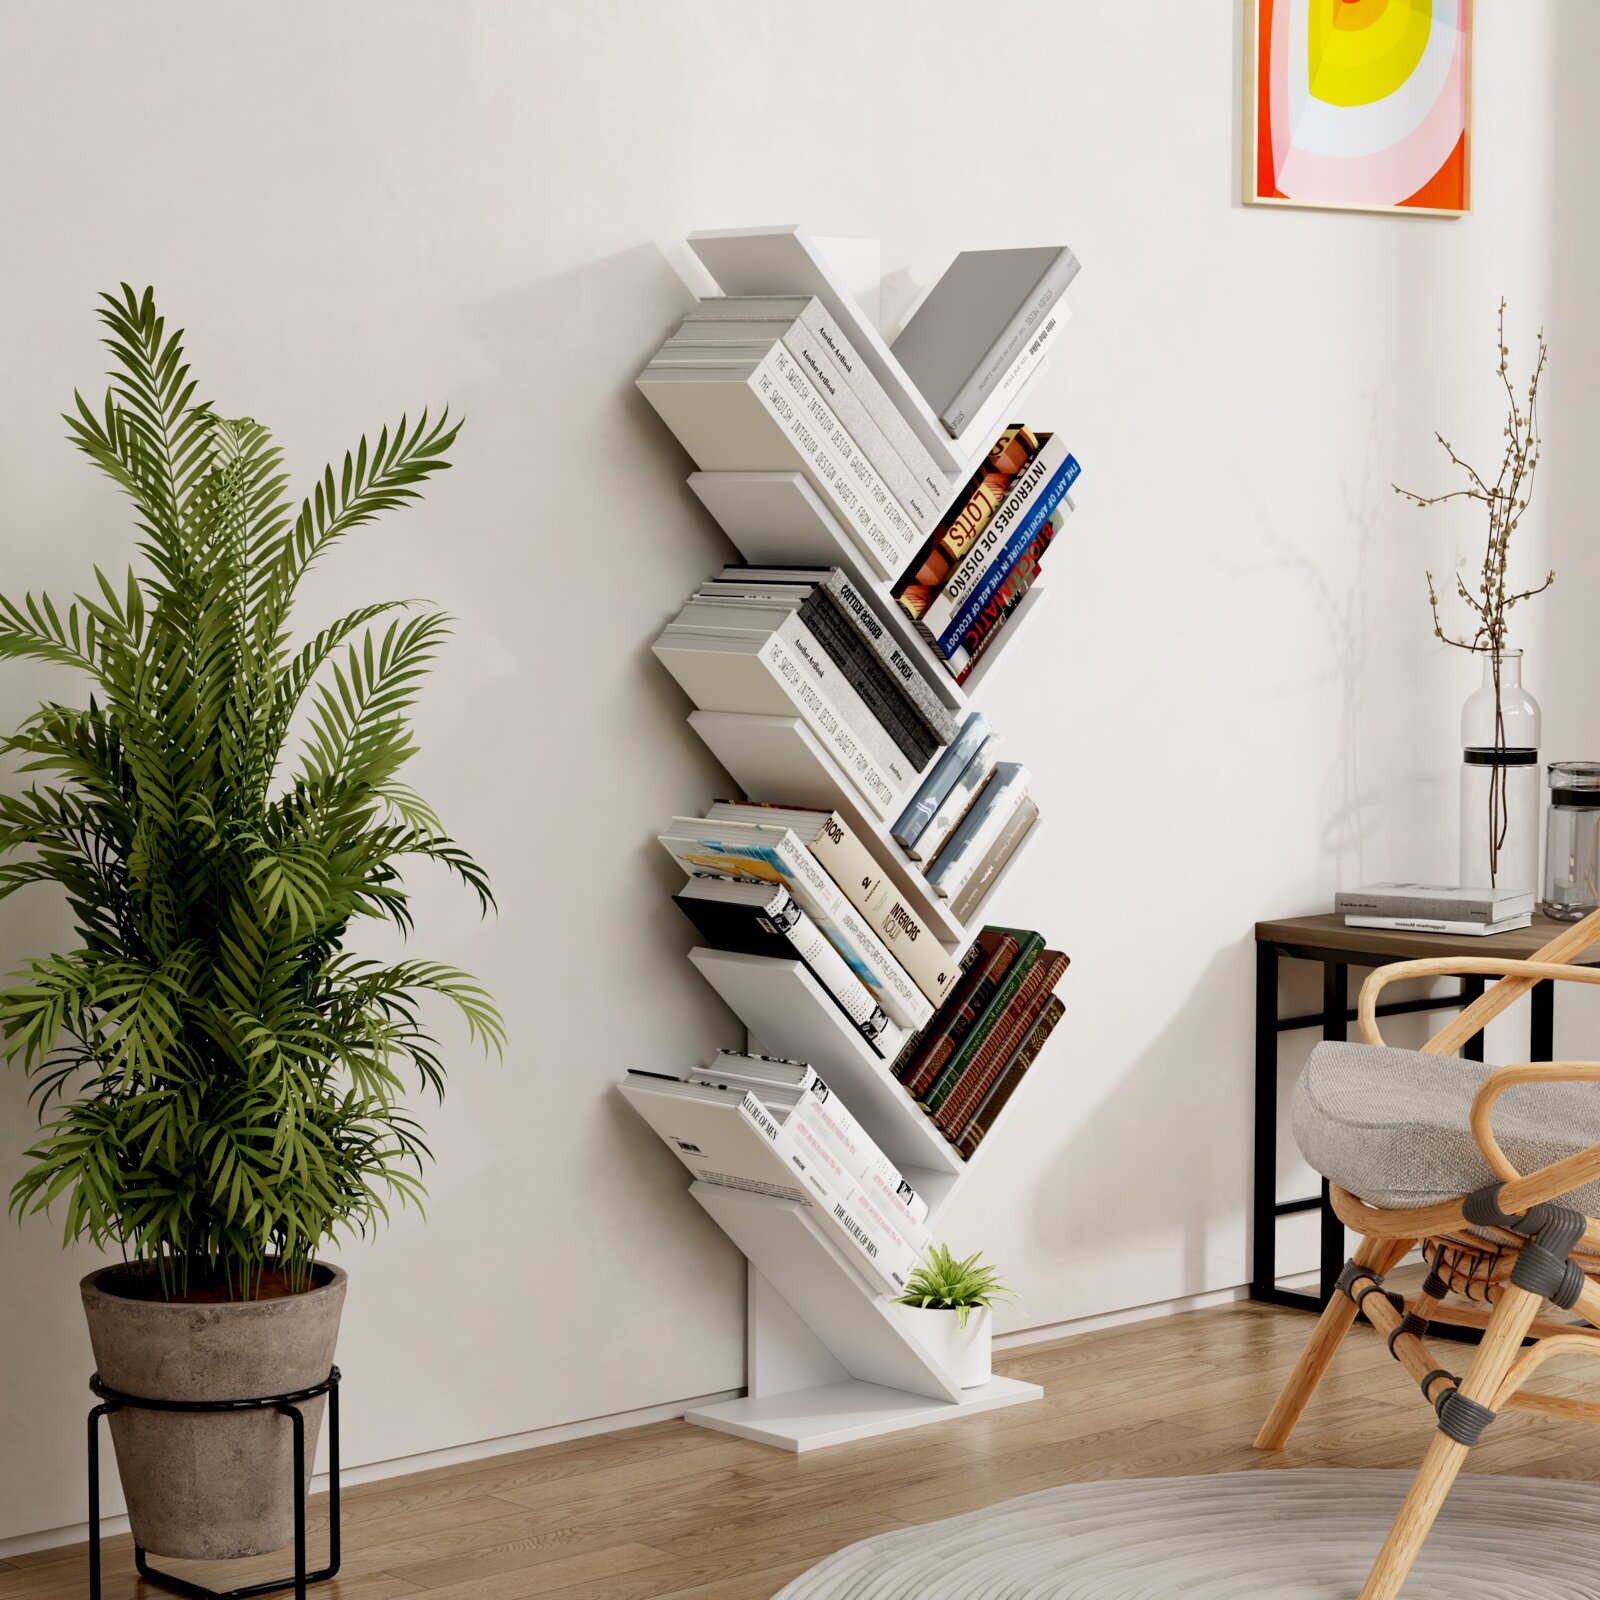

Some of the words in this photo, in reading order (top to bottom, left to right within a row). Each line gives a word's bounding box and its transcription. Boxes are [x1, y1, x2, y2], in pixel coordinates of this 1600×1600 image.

[1038, 330, 1047, 342] the
[1045, 317, 1056, 332] ride
[818, 327, 835, 350] Another
[834, 348, 851, 373] ArtBook
[1028, 339, 1040, 355] bike
[801, 349, 819, 372] Another
[817, 371, 835, 395] ArtBook
[775, 352, 788, 371] THE
[785, 367, 809, 400] SWEDISH
[807, 397, 834, 433] INTERIOR
[830, 430, 852, 459] DESIGN
[849, 455, 873, 487] GADGETS
[871, 484, 887, 505] FROM
[883, 501, 914, 544] EVERMOTION
[758, 373, 772, 393] THE
[769, 389, 793, 422] SWEDISH
[790, 418, 818, 455] INTERIOR
[814, 451, 836, 480] DESIGN
[834, 477, 857, 509] GADGETS
[855, 505, 871, 527] FROM
[867, 523, 898, 565] EVERMOTION
[1064, 463, 1078, 481] THE
[994, 460, 1046, 532] INTERIORES
[1054, 477, 1066, 496] ART
[1047, 493, 1056, 508] OF
[948, 490, 994, 548] Lofts
[980, 530, 997, 551] DE
[1007, 503, 1047, 563] ARCHITECTURE
[948, 548, 984, 597] DISEÑO
[988, 570, 1003, 588] THE
[1000, 560, 1009, 572] IN
[964, 521, 1055, 650] BIOCLIMATIC
[977, 585, 990, 605] AGE
[971, 602, 980, 616] OF
[946, 613, 972, 652] ECOLOGY
[795, 638, 810, 659] Another
[807, 656, 824, 678] ArtBook
[771, 643, 782, 662] THE
[777, 656, 798, 683] SWEDISH
[796, 680, 822, 713] INTERIOR
[817, 707, 838, 735] DESIGN
[834, 729, 857, 758] GADGETS
[855, 752, 868, 770] FROM
[864, 767, 892, 805] EVERMOTION
[861, 876, 871, 889] 2
[881, 914, 901, 941] NOW!
[889, 902, 920, 941] INTERIORS
[937, 972, 946, 984] 2
[758, 1115, 767, 1127] OF
[765, 1122, 776, 1140] MEN
[833, 1203, 845, 1219] THE
[843, 1215, 861, 1239] ALLURE
[859, 1234, 868, 1245] OF
[866, 1240, 877, 1258] MEN
